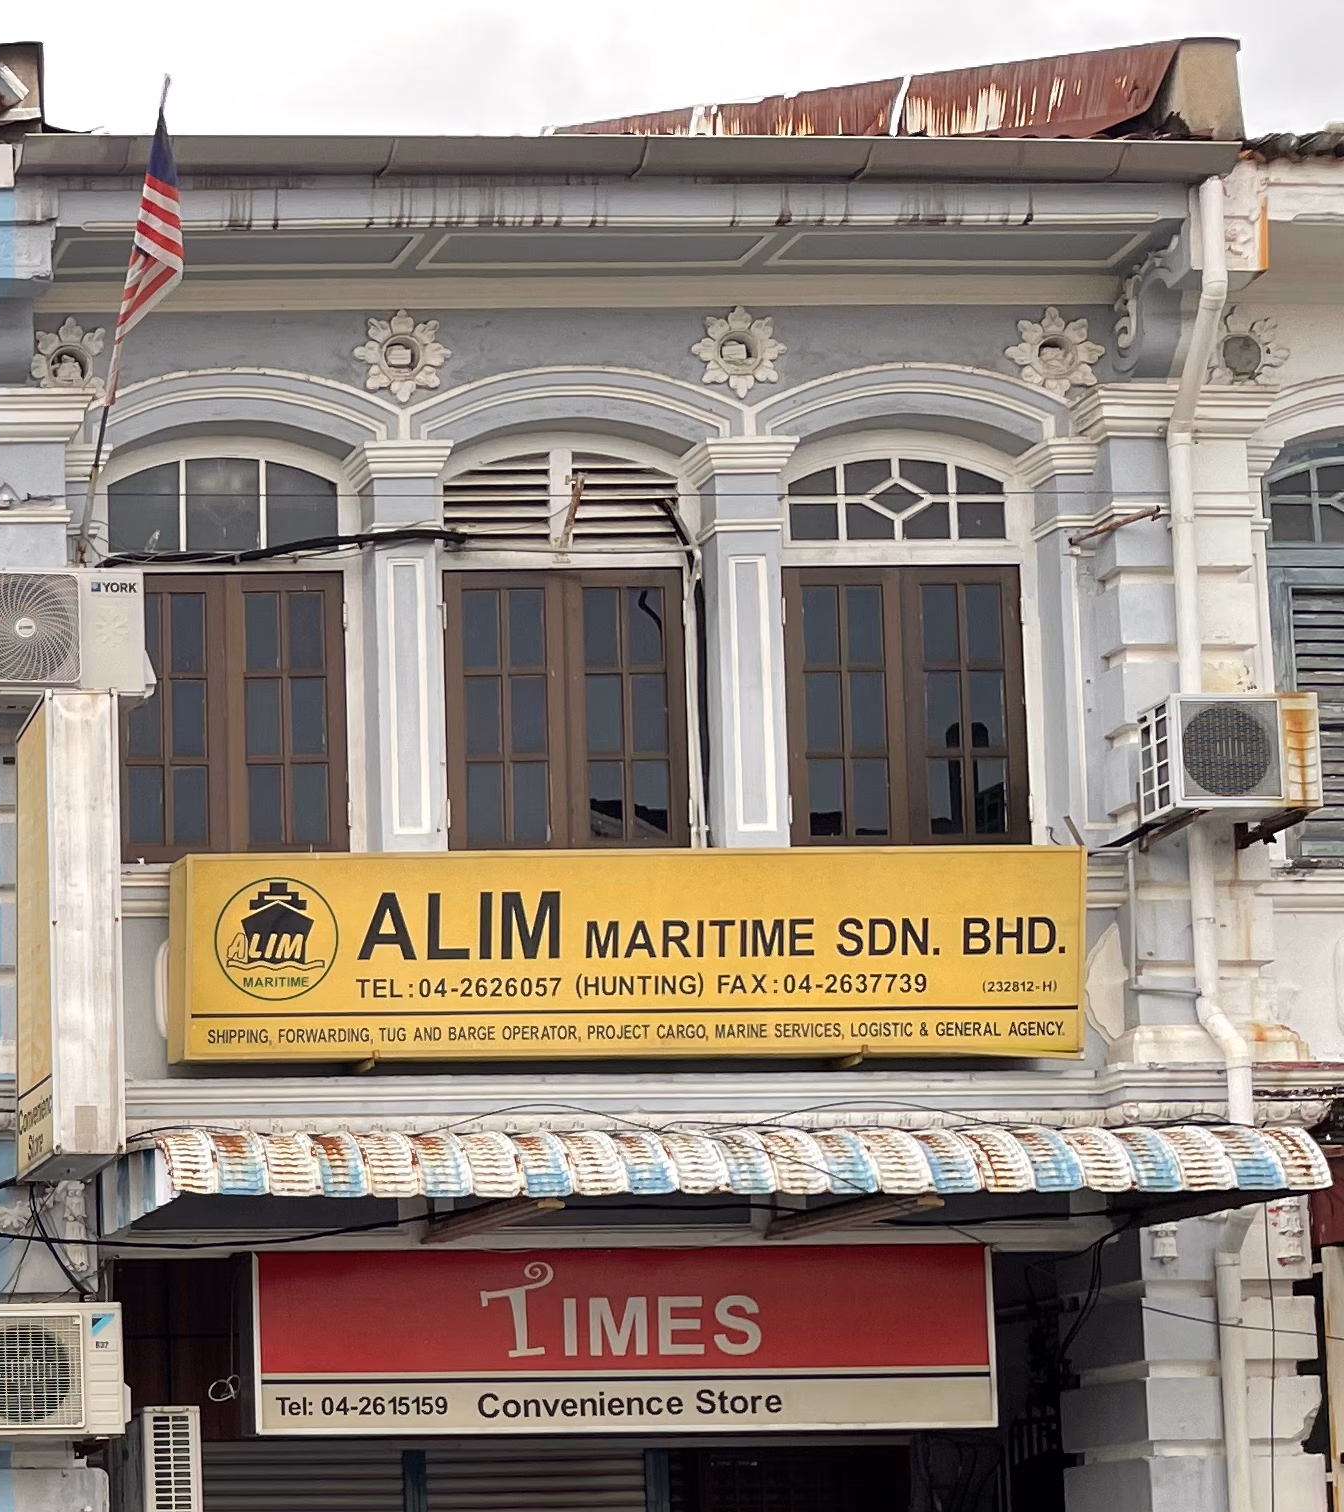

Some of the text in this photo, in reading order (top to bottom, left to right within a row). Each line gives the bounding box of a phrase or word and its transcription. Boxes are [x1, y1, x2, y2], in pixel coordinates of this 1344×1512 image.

[102, 582, 137, 593] YORK
[357, 890, 1066, 960] ALIM MARITIME SDN. BHD.
[227, 932, 304, 959] ALIM
[242, 976, 310, 988] MARITIME
[575, 973, 705, 997] (HUNTING)
[982, 979, 1057, 993] (232812-H)
[278, 1027, 374, 1045] FORWARDING,
[379, 1027, 406, 1042] TUG
[413, 1027, 443, 1042] AND
[448, 1026, 495, 1041] BARGE
[501, 1025, 581, 1042] OPERATOR,
[587, 1025, 649, 1040] PROJECT
[656, 1024, 709, 1041] CARGO,
[714, 1024, 768, 1039] MARINE
[774, 1023, 844, 1041] SERVICES,
[850, 1022, 913, 1038] LOGISTIC
[919, 1023, 929, 1037] &
[935, 1021, 1001, 1037] GENERAL
[480, 1261, 763, 1359] TIMES
[276, 1388, 783, 1420] Tel: 04-2615159 Convenience Store
